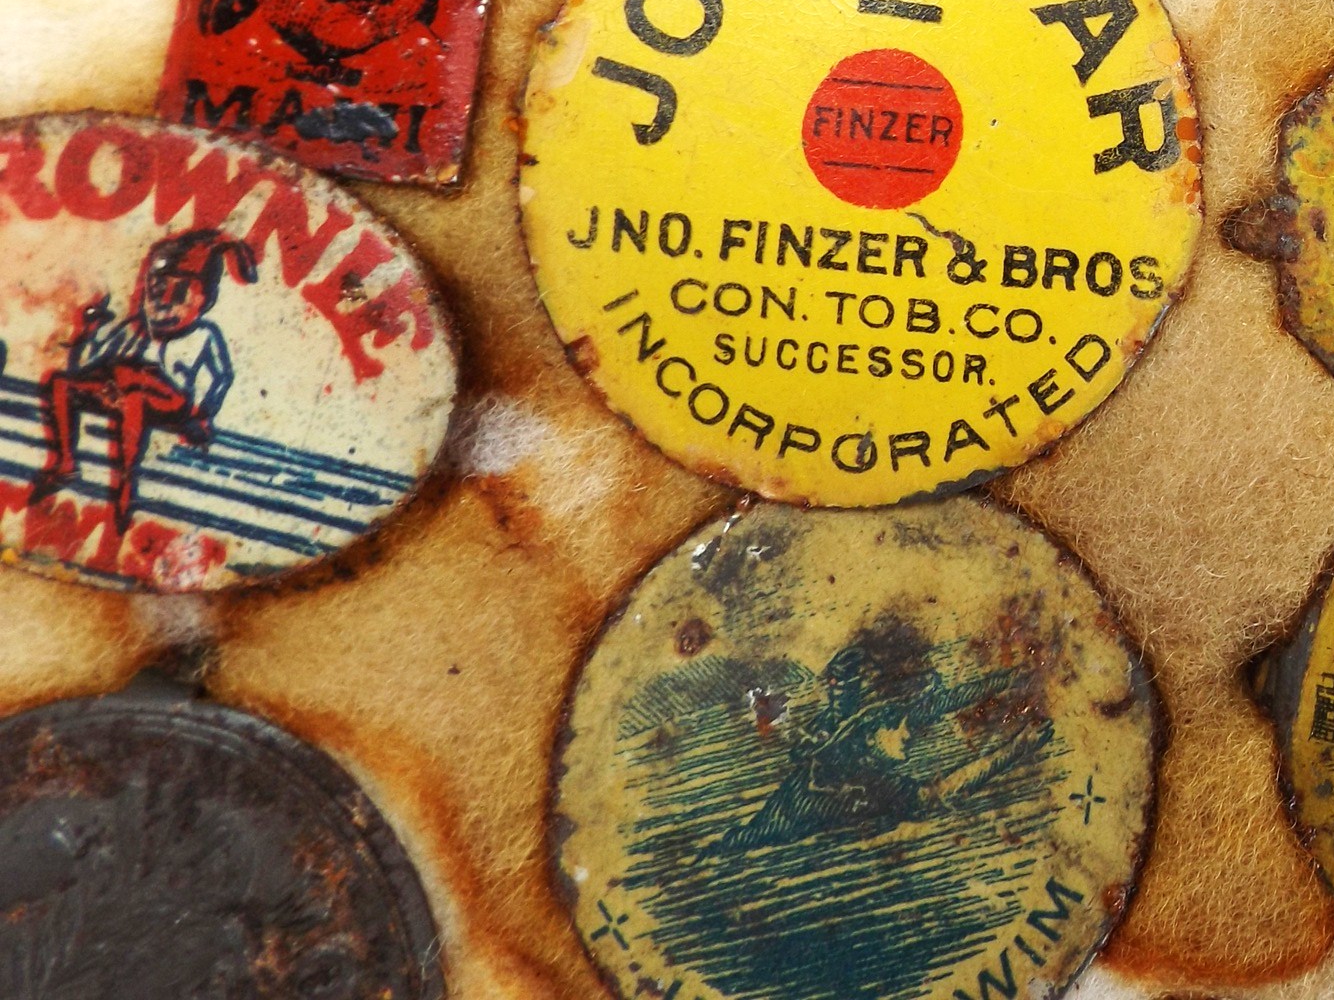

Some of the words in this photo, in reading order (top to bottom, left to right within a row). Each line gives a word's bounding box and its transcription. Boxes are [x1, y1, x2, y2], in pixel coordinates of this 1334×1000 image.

[811, 104, 955, 149] FINZER
[566, 205, 704, 260] JNO.
[719, 219, 930, 279] FINZER
[945, 238, 988, 287] &
[999, 244, 1166, 300] BROS
[670, 276, 809, 322] CON.
[602, 287, 1121, 476] INCORPORATED
[713, 333, 998, 387] SUCCESSOR.
